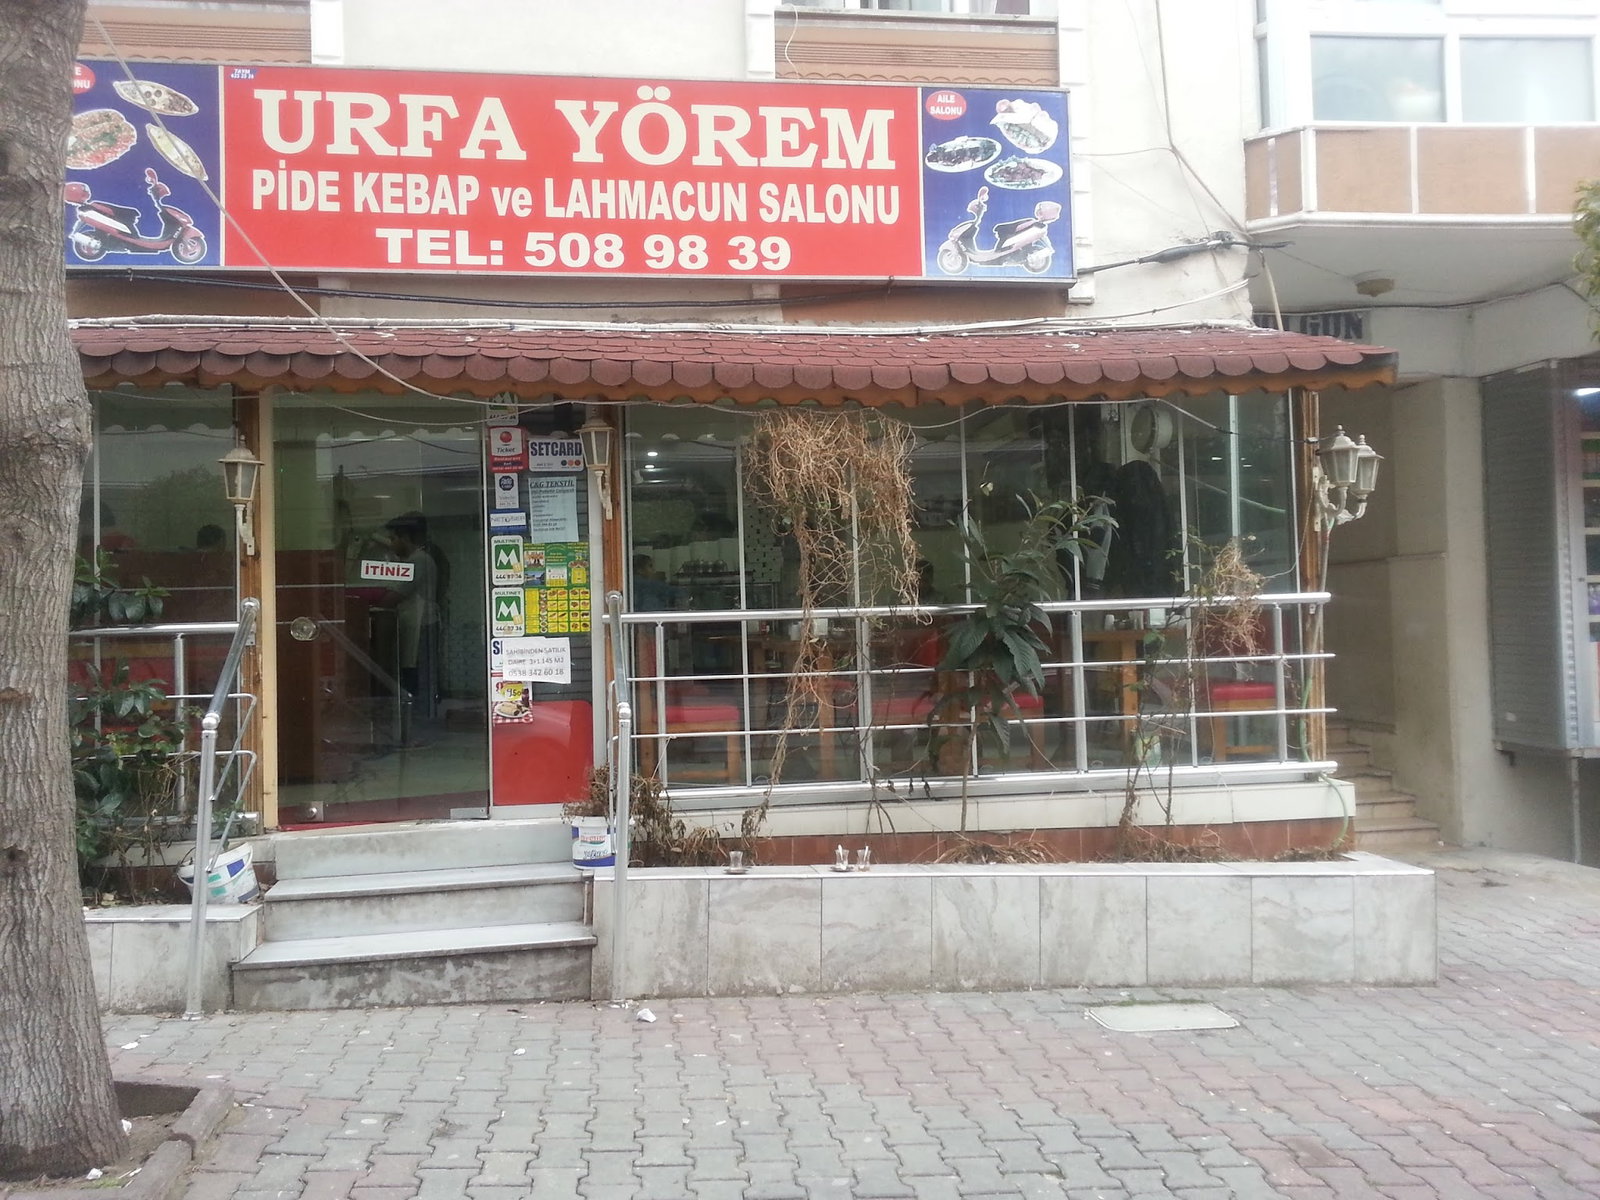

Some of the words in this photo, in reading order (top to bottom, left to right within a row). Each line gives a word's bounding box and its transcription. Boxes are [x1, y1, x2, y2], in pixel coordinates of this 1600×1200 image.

[930, 105, 963, 116] SALONU
[253, 88, 527, 160] URFA
[555, 85, 896, 170] YÖREM
[252, 159, 340, 211] PİDE
[353, 172, 480, 216] KEBAP
[490, 186, 532, 217] ve
[544, 177, 747, 222] LAHMACUN
[758, 183, 900, 225] SALONU
[375, 227, 504, 267] TEL:
[524, 231, 625, 269] 508
[643, 234, 709, 271] 98
[727, 235, 792, 271] 39
[530, 441, 583, 457] SETCARD
[365, 562, 410, 577] İTİNİZ
